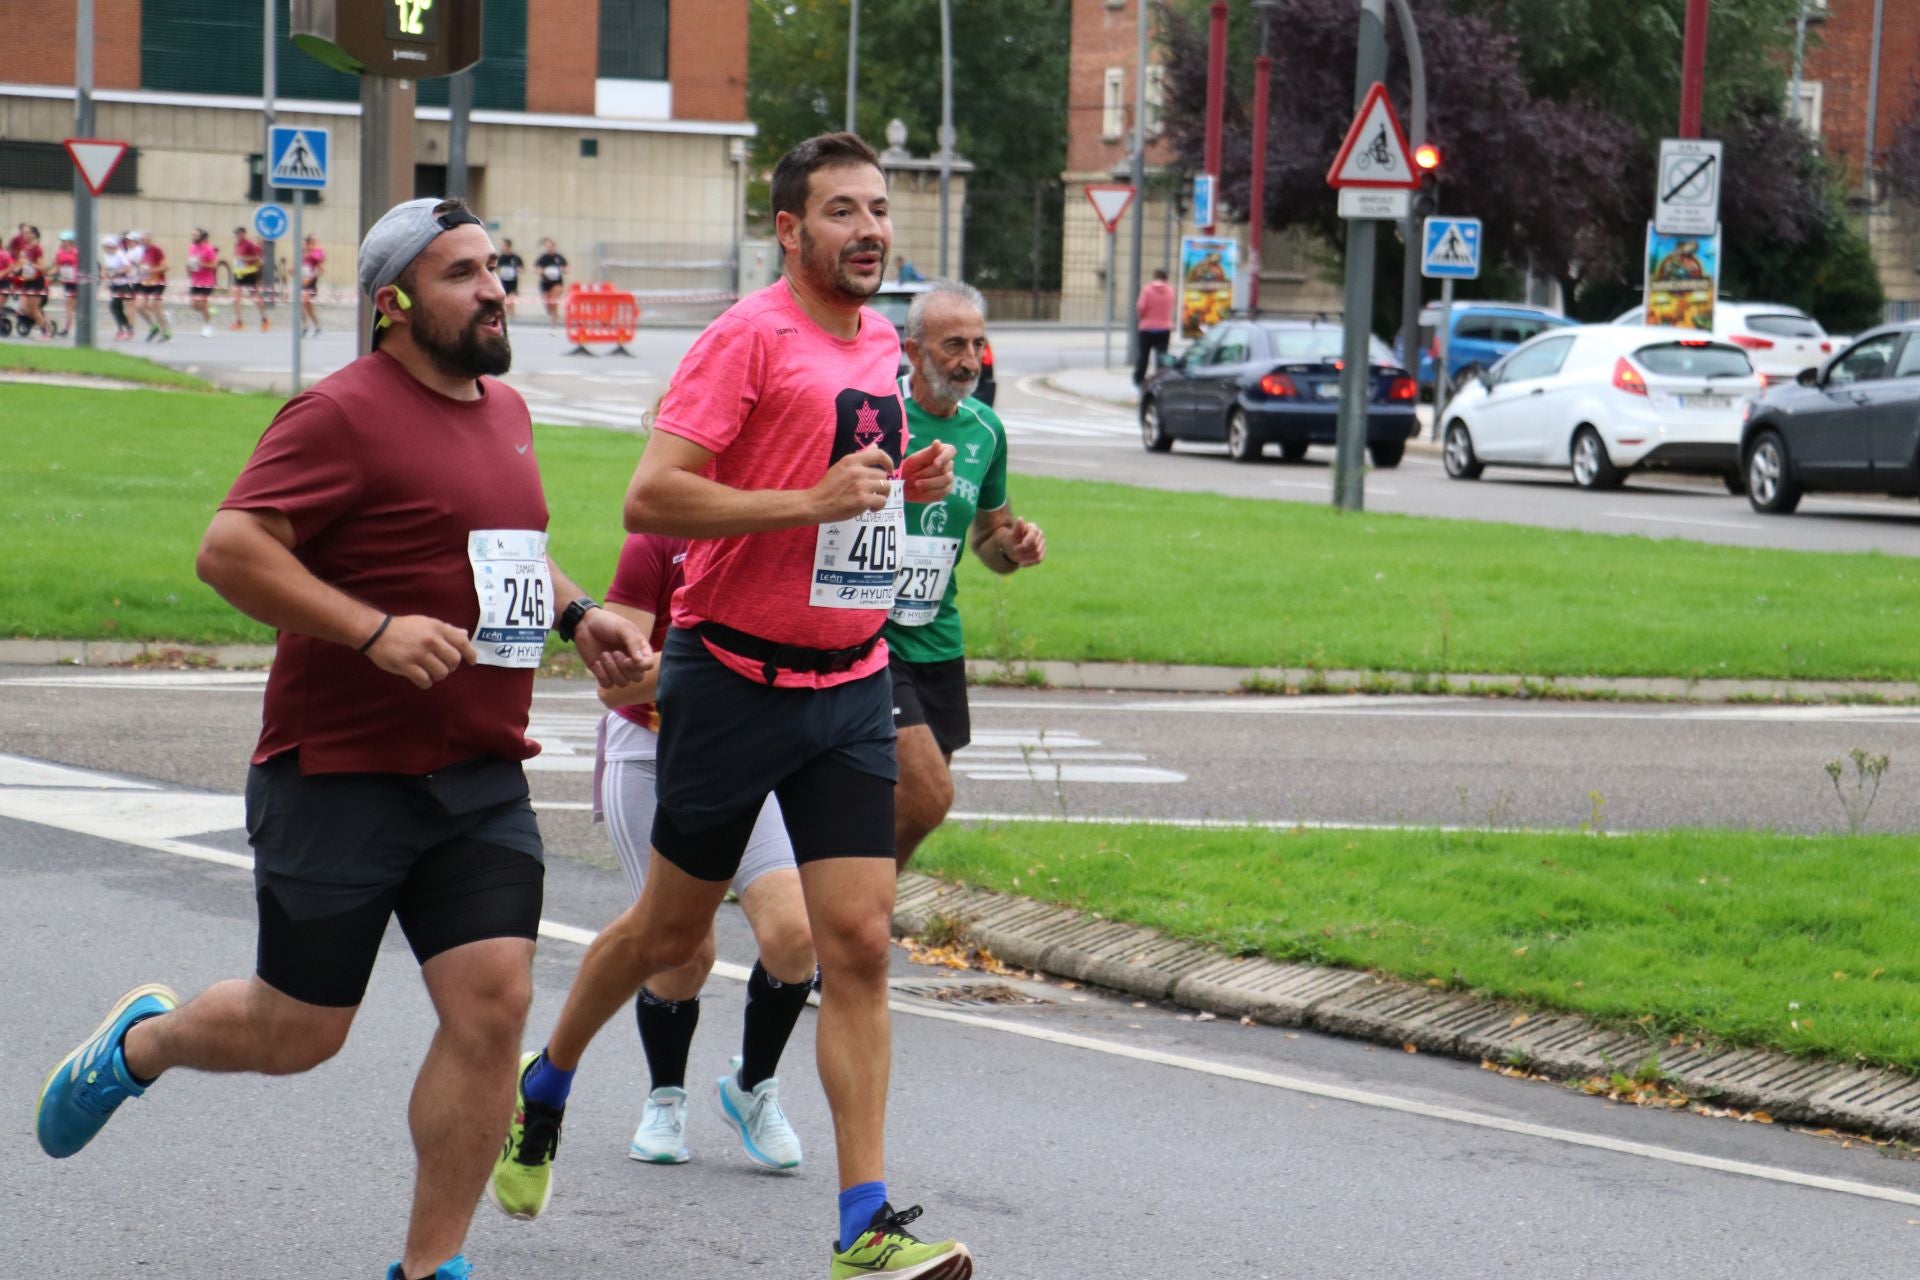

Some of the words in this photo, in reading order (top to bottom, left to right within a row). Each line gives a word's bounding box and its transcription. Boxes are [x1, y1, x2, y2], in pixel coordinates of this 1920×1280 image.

[848, 526, 896, 570] 409
[504, 578, 545, 626] 246
[897, 567, 940, 599] 237
